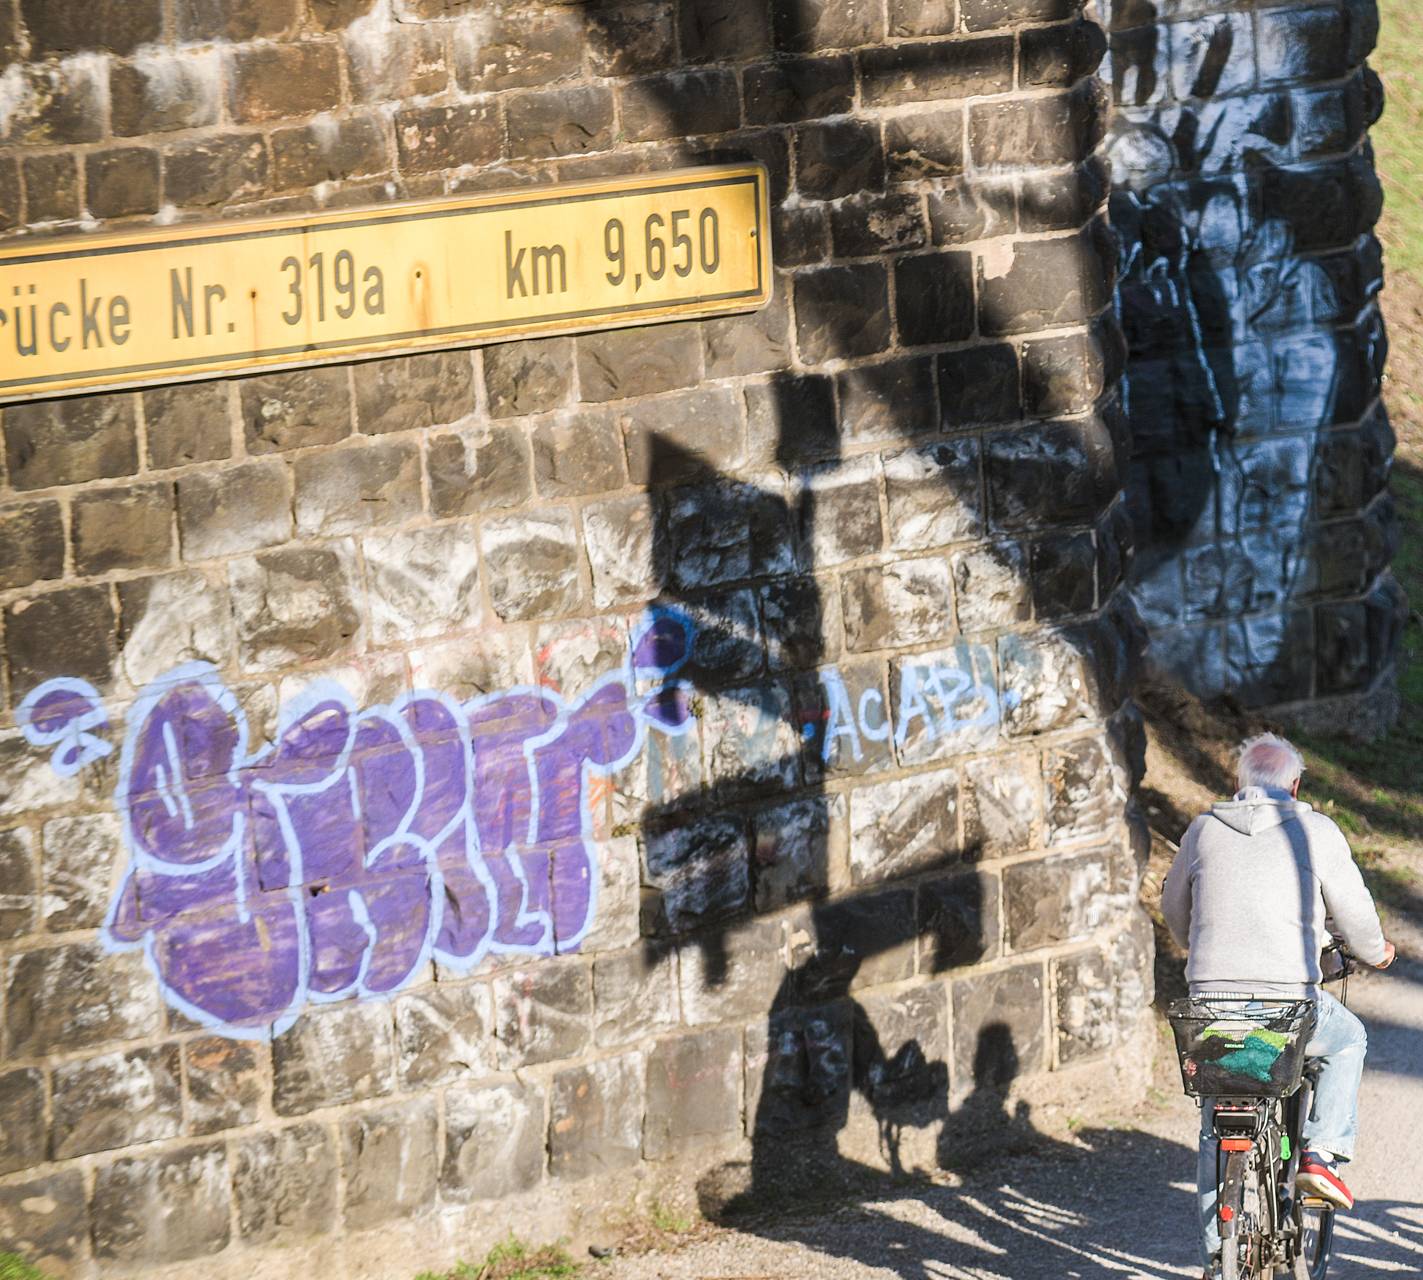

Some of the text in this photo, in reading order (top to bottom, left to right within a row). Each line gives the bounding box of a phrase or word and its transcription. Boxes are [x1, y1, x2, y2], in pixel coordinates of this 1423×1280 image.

[170, 267, 235, 338] Nr.
[280, 250, 386, 326] 319a
[505, 231, 567, 298] km
[604, 207, 721, 294] 9,650
